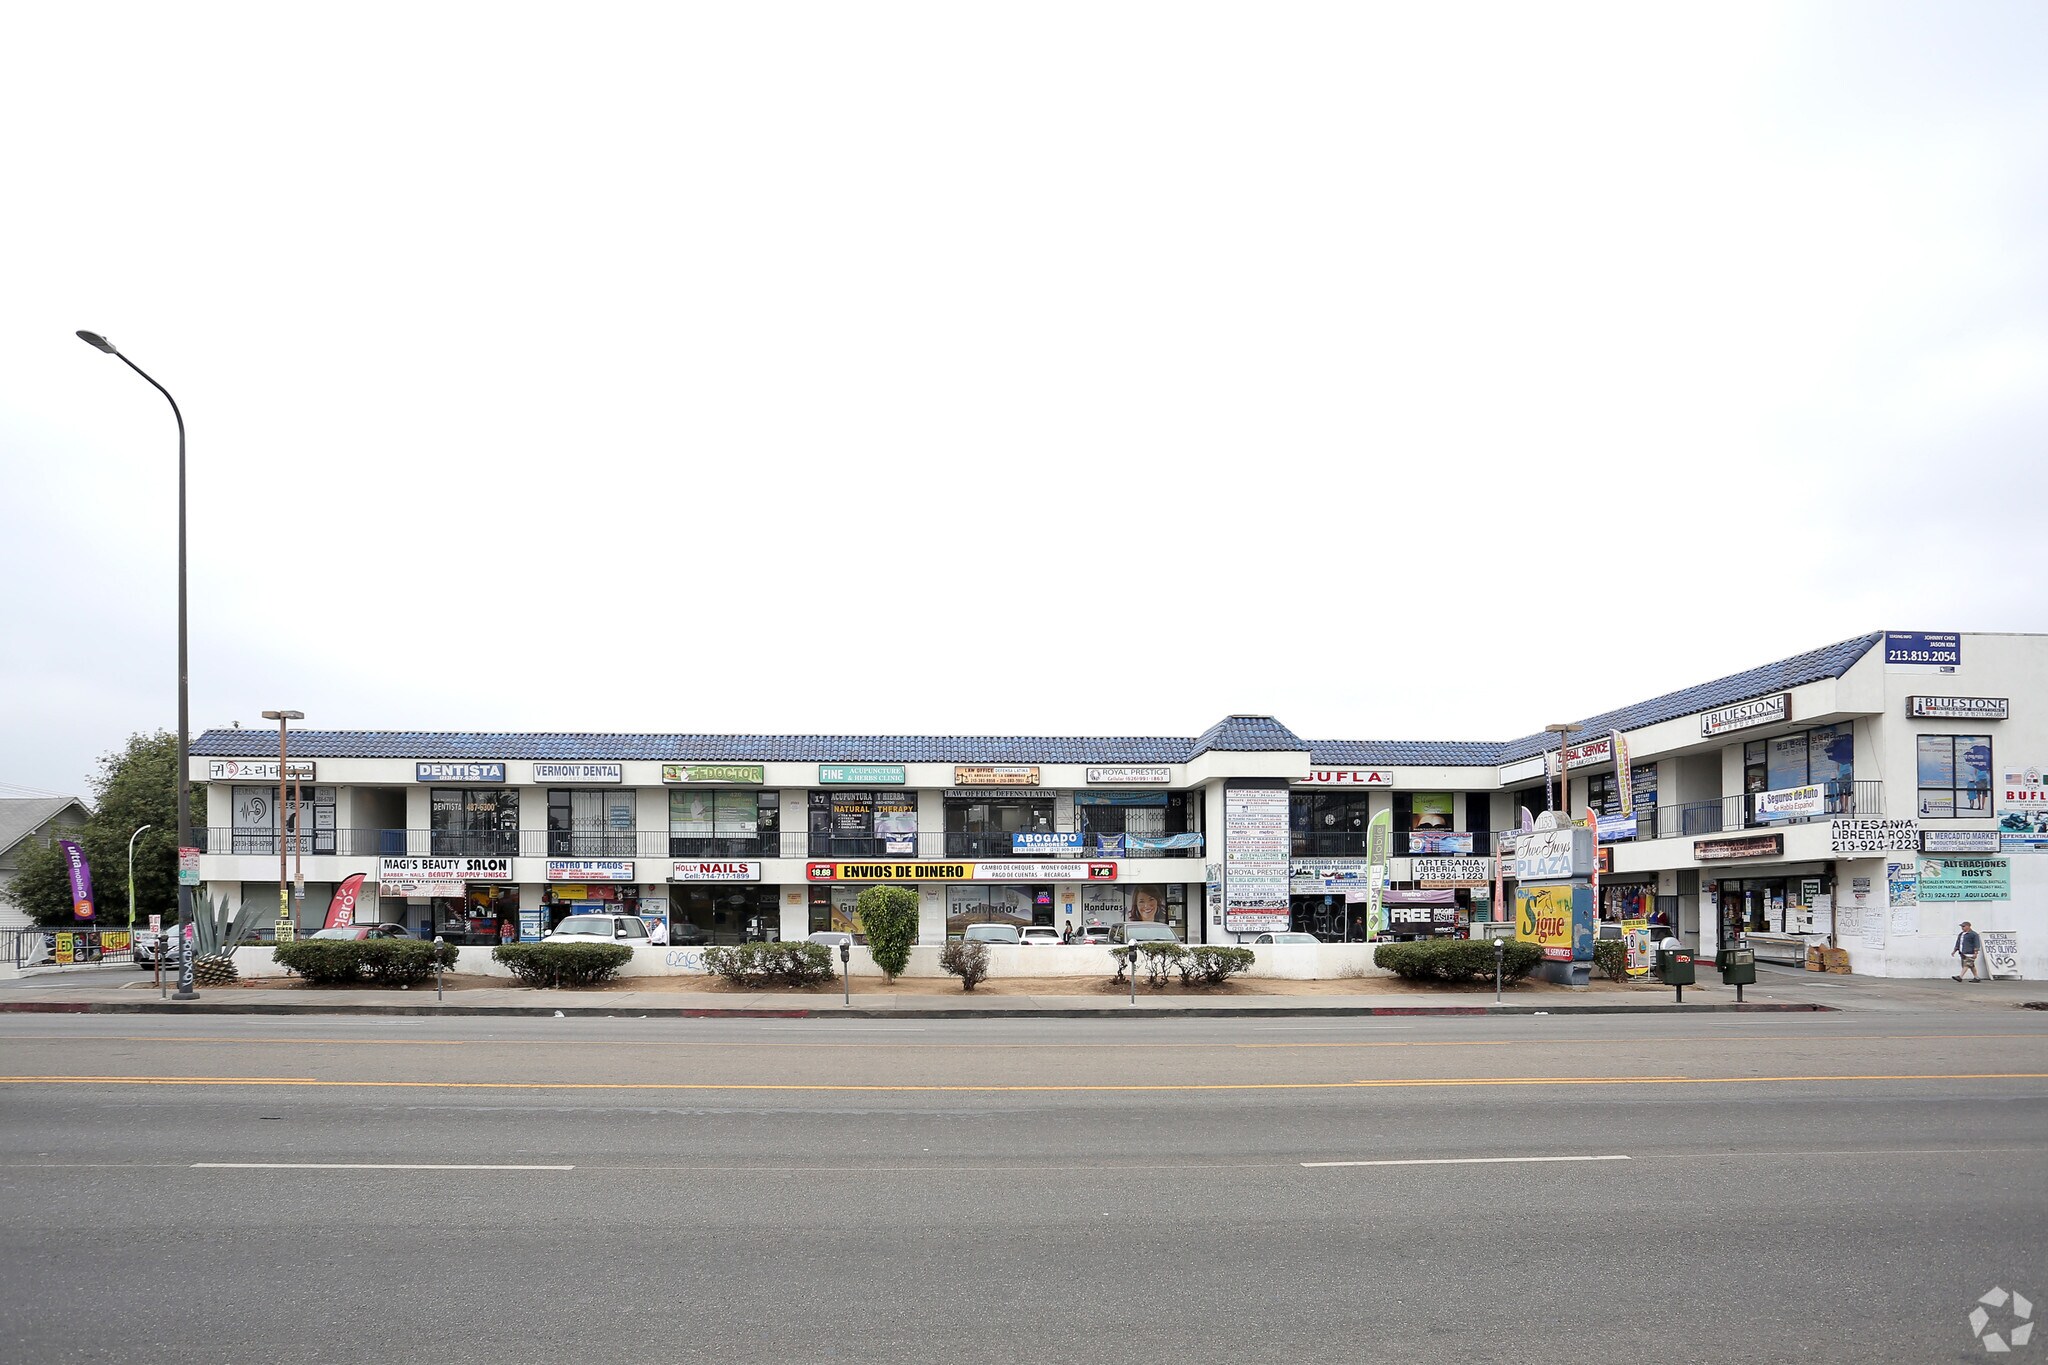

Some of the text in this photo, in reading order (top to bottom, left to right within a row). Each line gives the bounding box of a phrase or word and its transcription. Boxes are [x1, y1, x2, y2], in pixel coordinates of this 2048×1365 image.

[1889, 650, 1956, 662] 213.819.2054
[1925, 698, 2005, 708] BLUESTONE
[1712, 697, 1784, 724] BLUESTONE
[1582, 742, 1609, 757] SERVICE
[211, 764, 224, 777] 귀
[420, 764, 500, 776] DENTISTA
[536, 766, 618, 776] VERMONT DENTAL
[707, 768, 760, 780] DOCTOR
[822, 770, 844, 780] FINE
[814, 795, 825, 804] 17
[831, 792, 872, 800] ACUPUNTURA
[877, 792, 881, 800] Y
[1768, 788, 1818, 805] Seguros de Auto
[434, 803, 462, 811] DENTISTA
[1794, 800, 1814, 810] Español
[1832, 820, 1914, 830] ARTESANIA
[1017, 834, 1078, 842] ABOGADO
[1832, 830, 1918, 840] LIBRERIA ROSY
[1373, 826, 1384, 864] Mobile
[1518, 836, 1542, 859] Two
[1542, 831, 1572, 862] Guys
[1832, 840, 1920, 851] 213-924-1223
[68, 846, 84, 892] ultra mobile
[384, 859, 507, 870] MAGI'S BEAUTY SALON
[700, 864, 748, 873] NAILS
[1518, 856, 1572, 877] PLAZA
[844, 866, 964, 878] ENVIOS DE DINERO
[1370, 866, 1383, 911] SIMPLE
[952, 902, 1018, 914] El Salvador
[1084, 903, 1123, 912] Honduras
[1391, 908, 1431, 922] FREE
[1522, 896, 1564, 944] Sigue
[57, 940, 72, 952] LED
[1550, 949, 1570, 958] SERVICES
